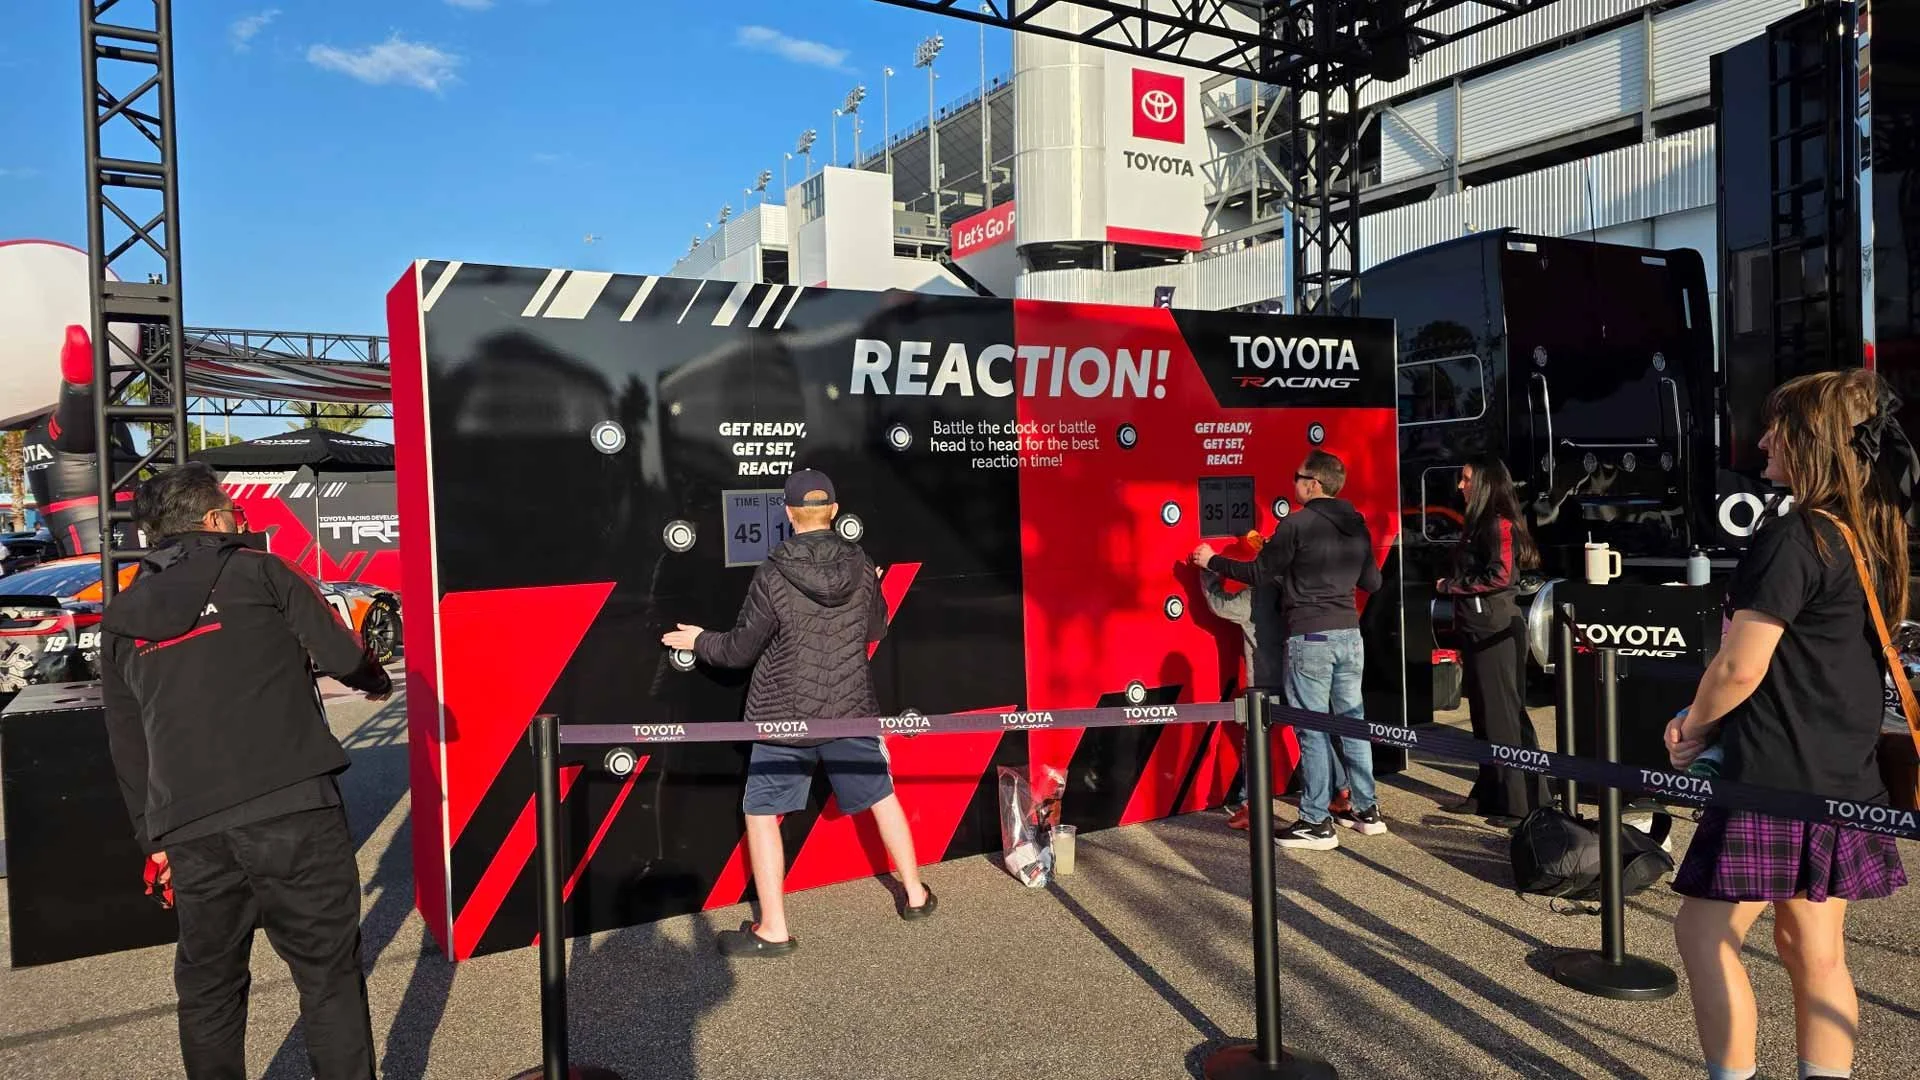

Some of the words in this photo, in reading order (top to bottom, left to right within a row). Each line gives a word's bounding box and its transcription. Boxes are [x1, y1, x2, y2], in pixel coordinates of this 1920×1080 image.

[1123, 150, 1195, 177] TOYOTA
[958, 224, 984, 250] Let's
[986, 218, 1004, 238] Go
[1230, 336, 1360, 370] TOYOTA
[850, 339, 1170, 399] REACTION!
[1232, 376, 1360, 389] RACING
[719, 423, 751, 436] GET
[753, 422, 807, 438] READY,
[933, 420, 974, 435] Battle
[978, 421, 1001, 435] the
[1003, 420, 1038, 434] clock
[1041, 423, 1056, 434] or
[1058, 420, 1096, 434] battle
[1195, 422, 1216, 434] GET
[1217, 422, 1252, 435] READY,
[732, 442, 763, 456] GET
[765, 442, 796, 458] SET,
[930, 437, 966, 452] head
[970, 439, 985, 452] to
[988, 437, 1022, 452] head
[1025, 437, 1044, 451] for
[1046, 437, 1068, 451] the
[1071, 437, 1100, 450] best
[1203, 438, 1224, 450] GET
[1225, 438, 1245, 450] SET,
[972, 455, 1027, 469] reaction
[1030, 454, 1063, 468] time!
[1206, 454, 1243, 465] REACT!
[738, 462, 793, 476] REACT!
[734, 497, 760, 507] TIME
[1205, 503, 1224, 520] 35
[1232, 502, 1250, 519] 22
[734, 524, 762, 544] 45
[44, 636, 68, 652] 19
[1000, 712, 1053, 724] TOYOTA
[1124, 706, 1178, 719] TOYOTA
[632, 724, 686, 736] TOYOTA
[756, 721, 808, 733] TOYOTA
[878, 716, 931, 729] TOYOTA
[1368, 722, 1418, 743] TOYOTA
[1490, 744, 1550, 767] TOYOTA
[1640, 769, 1714, 795] TOYOTA
[1825, 799, 1918, 829] TOYOTA
